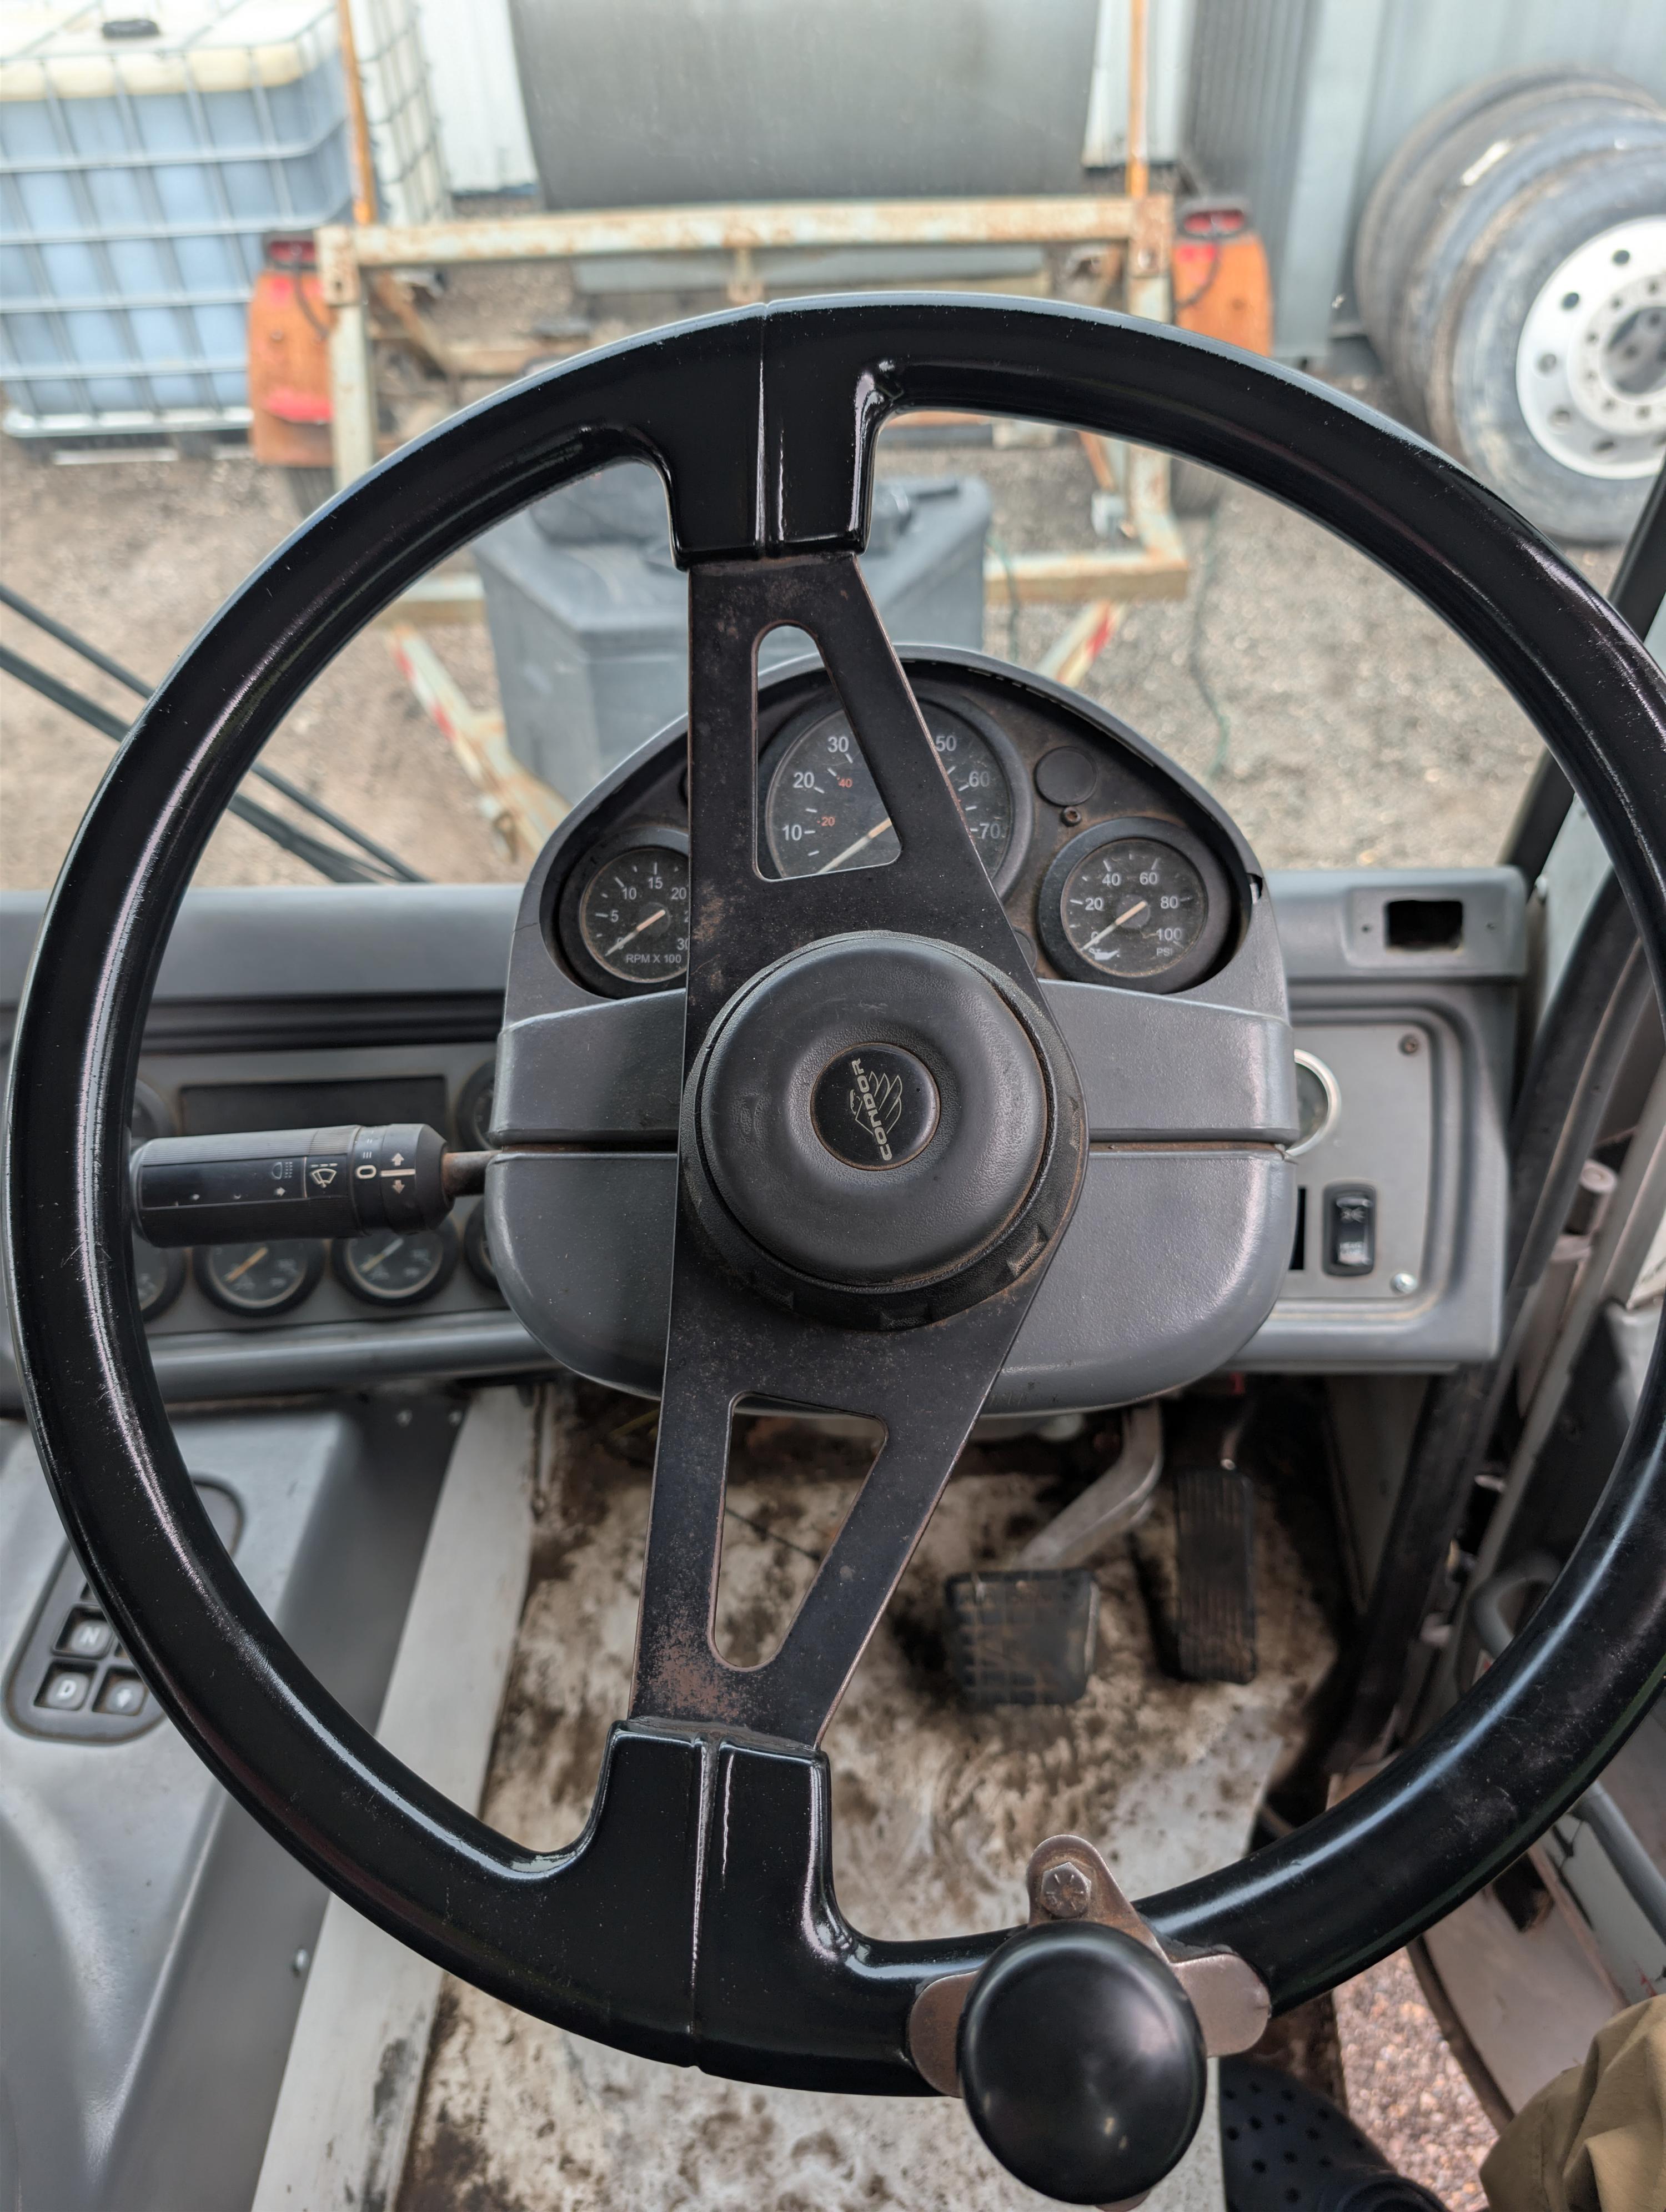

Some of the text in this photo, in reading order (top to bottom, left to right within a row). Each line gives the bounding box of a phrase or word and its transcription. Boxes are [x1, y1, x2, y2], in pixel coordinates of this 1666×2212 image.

[827, 736, 849, 753] 30
[936, 735, 957, 751] 50
[793, 772, 815, 788] 20
[838, 778, 853, 788] 40
[969, 771, 990, 787] 60
[821, 817, 836, 827] 20
[782, 825, 802, 841] 10
[980, 823, 1000, 839] 70
[648, 877, 663, 889] 15
[1102, 873, 1122, 887] 40
[1139, 872, 1158, 886] 60
[622, 887, 637, 900] 10
[671, 887, 687, 899] 20
[1085, 898, 1105, 911] 20
[1160, 896, 1178, 909] 80
[611, 910, 619, 923] 5
[1156, 928, 1183, 941] 100
[626, 954, 682, 963] RPM X 100
[1156, 947, 1173, 957] PSI
[80, 1626, 101, 1644] N
[56, 1679, 77, 1700] D
